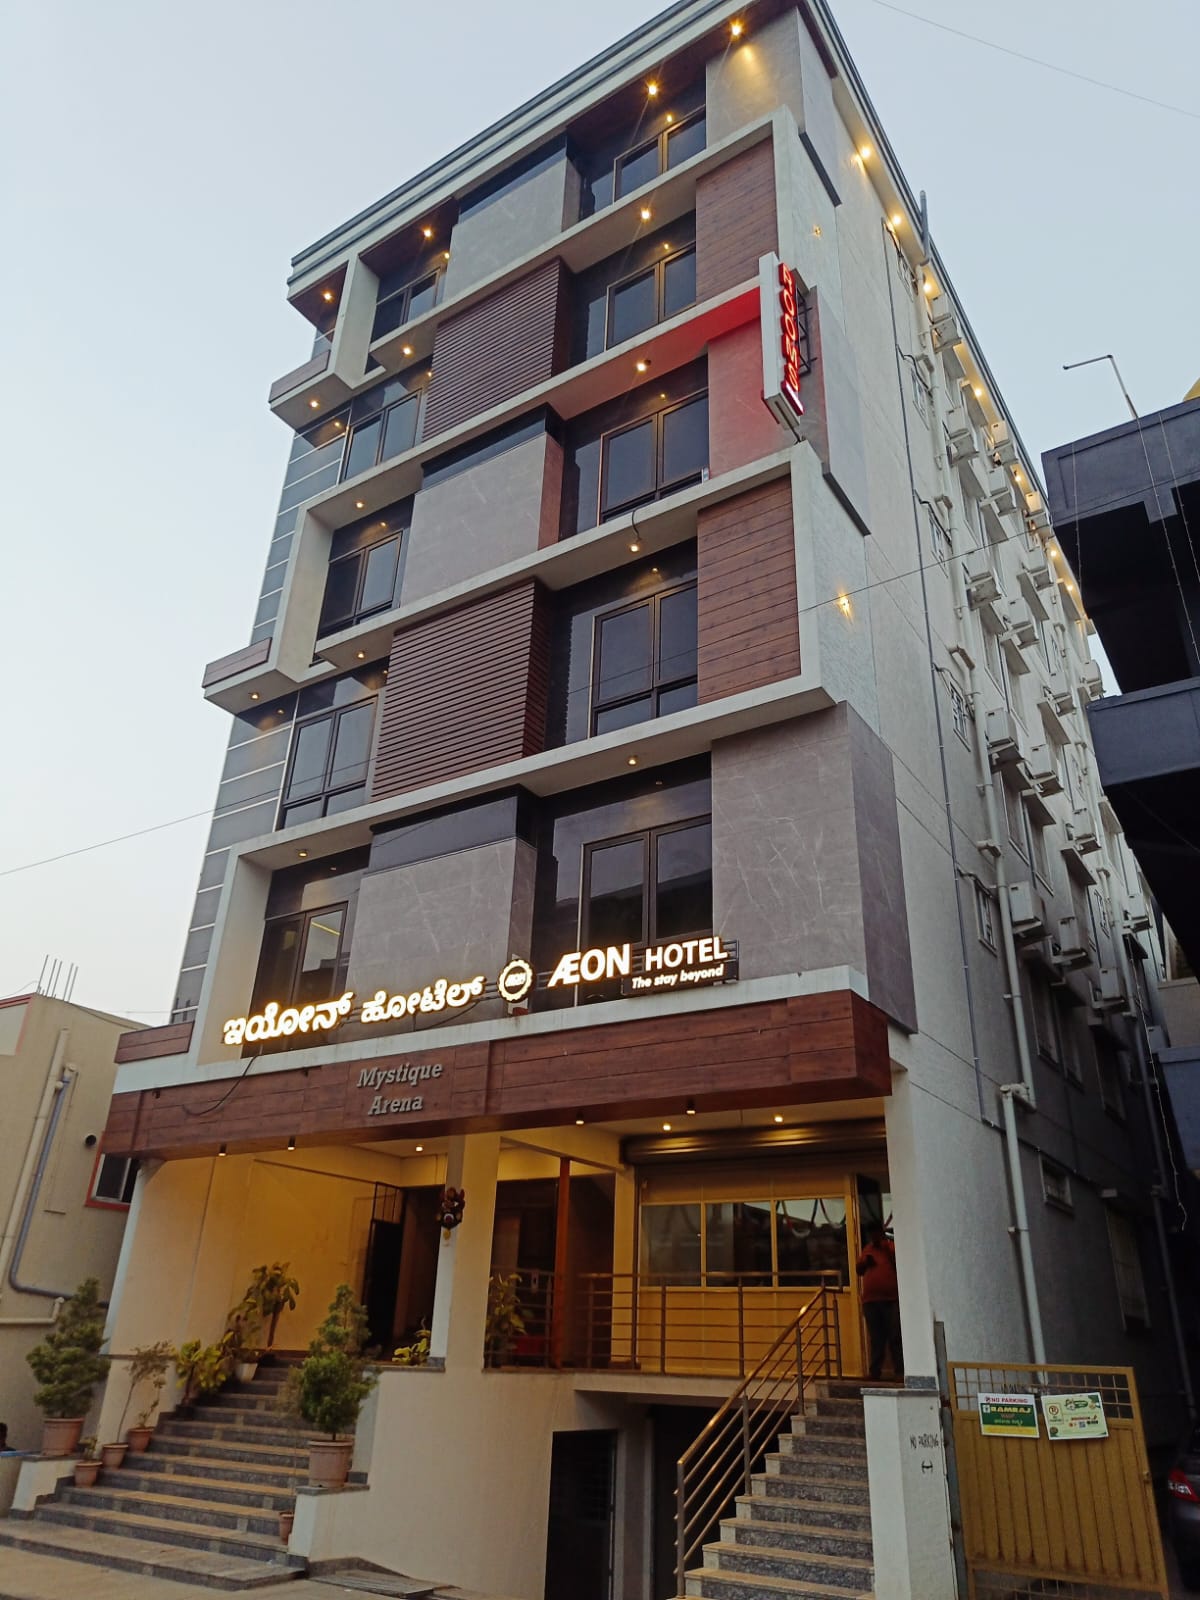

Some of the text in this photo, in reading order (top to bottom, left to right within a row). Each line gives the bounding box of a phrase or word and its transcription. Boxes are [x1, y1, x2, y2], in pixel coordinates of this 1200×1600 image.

[645, 937, 728, 971] HOTEL
[631, 964, 724, 989] The stay beyond
[356, 1062, 443, 1090] Mystique
[367, 1095, 424, 1116] Arena
